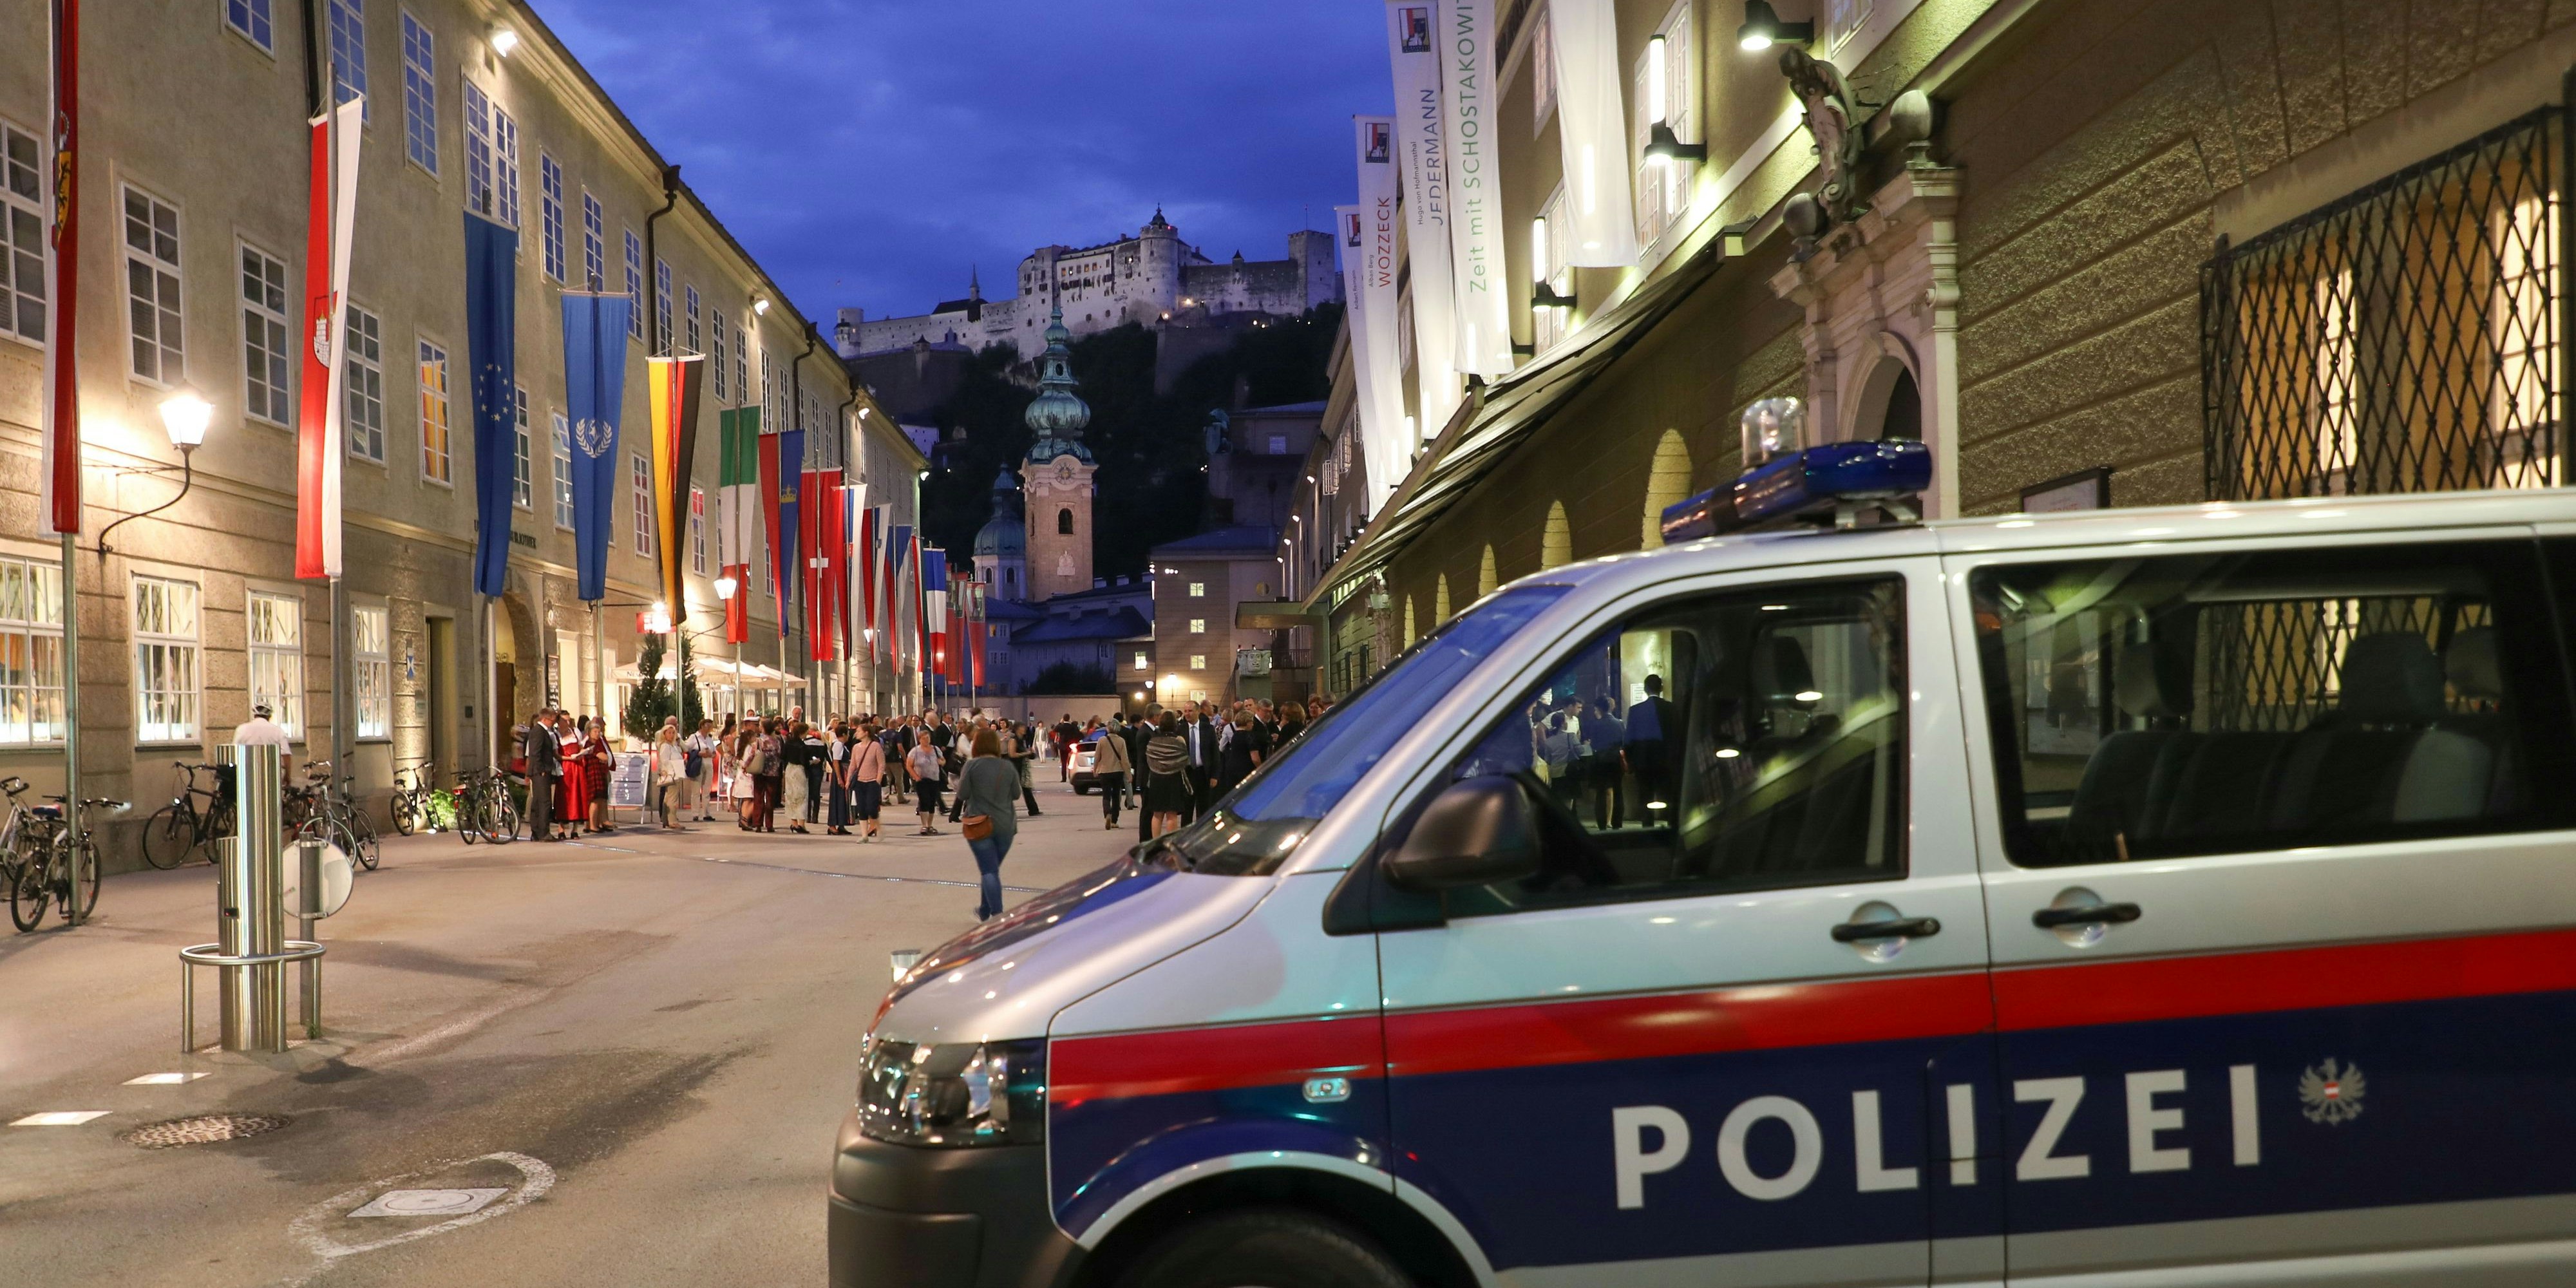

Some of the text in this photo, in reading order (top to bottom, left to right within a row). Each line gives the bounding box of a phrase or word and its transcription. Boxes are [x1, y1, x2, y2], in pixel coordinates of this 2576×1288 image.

[1411, 141, 1421, 189] Hofmannsthal
[1420, 90, 1443, 225] JEDERMANN
[1457, 0, 1486, 292] Zeit mit SCHOSTAKOWI
[1377, 197, 1391, 287] WOZZECK
[1612, 1064, 2260, 1209] POLIZEI
